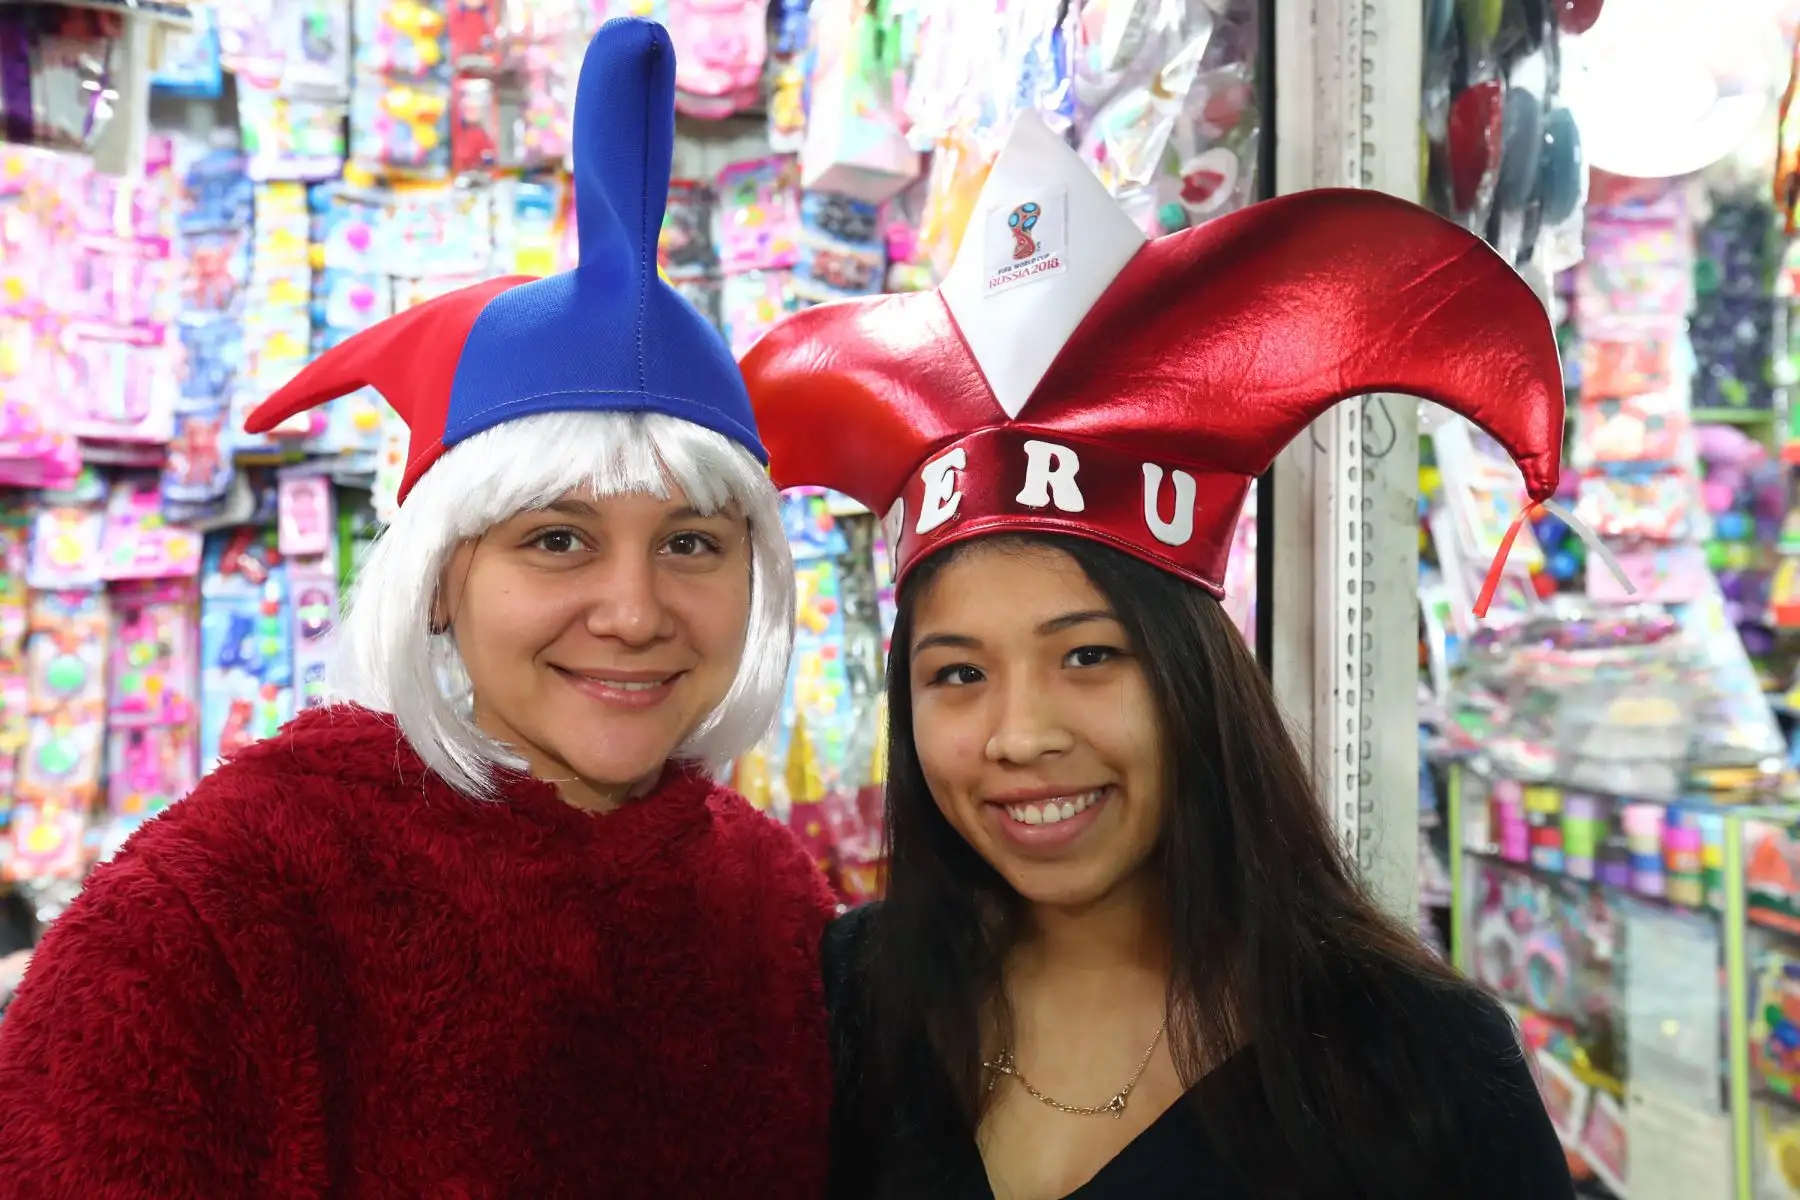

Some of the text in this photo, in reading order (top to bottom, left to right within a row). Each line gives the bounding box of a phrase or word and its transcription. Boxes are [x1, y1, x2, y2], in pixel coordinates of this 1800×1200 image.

[989, 257, 1060, 289] RUSSIA 2018
[998, 253, 1050, 275] FIFA WORLD CUP
